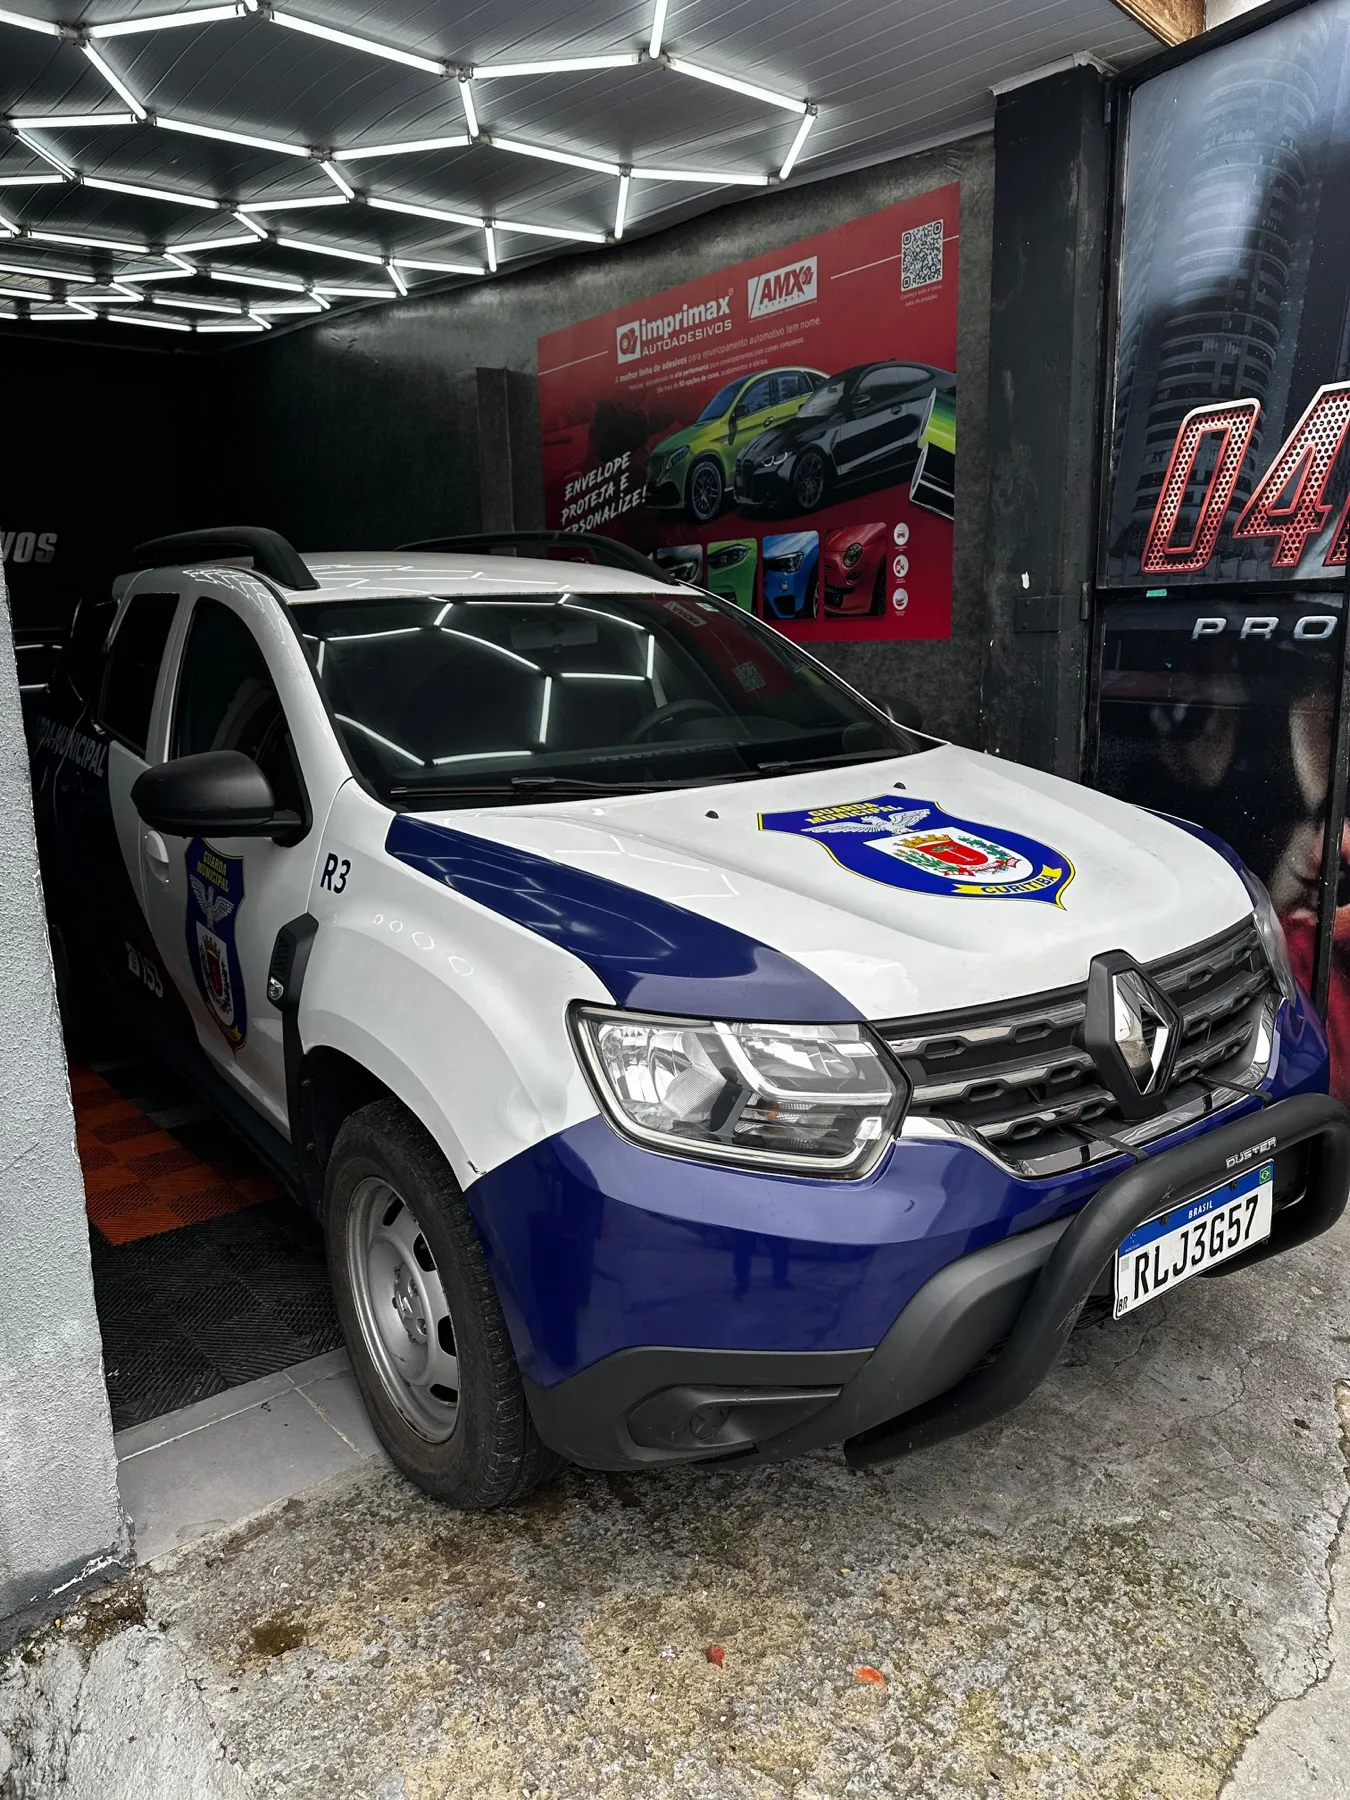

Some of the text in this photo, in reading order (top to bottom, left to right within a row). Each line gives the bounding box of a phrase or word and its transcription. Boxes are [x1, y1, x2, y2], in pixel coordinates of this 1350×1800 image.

[760, 266, 805, 304] AMX
[641, 294, 731, 341] imprimax
[642, 319, 732, 357] AUTOADESIVOS
[653, 362, 660, 372] de
[662, 355, 687, 370] adesivos
[702, 337, 747, 359] envelopamento
[749, 326, 784, 344] automotivo
[786, 322, 798, 333] tem
[800, 315, 821, 329] nome.
[564, 451, 631, 501] ENVELOPE
[1141, 380, 1350, 574] 04
[560, 472, 630, 526] PROTEJA E
[1191, 615, 1338, 640] PRO
[51, 722, 108, 778] MUNICIPAL
[804, 805, 904, 824] MUNICIPAL
[807, 802, 879, 817] GUARDA
[196, 860, 230, 893] MUNICIPAL
[202, 851, 228, 874] GUARDA
[320, 852, 351, 894] R3
[980, 874, 1058, 894] CURITIBA
[1225, 1136, 1277, 1169] DUSTER
[1188, 1199, 1214, 1219] BRASIL
[1133, 1194, 1259, 1300] RLJ3G57
[1118, 1295, 1128, 1313] BR
